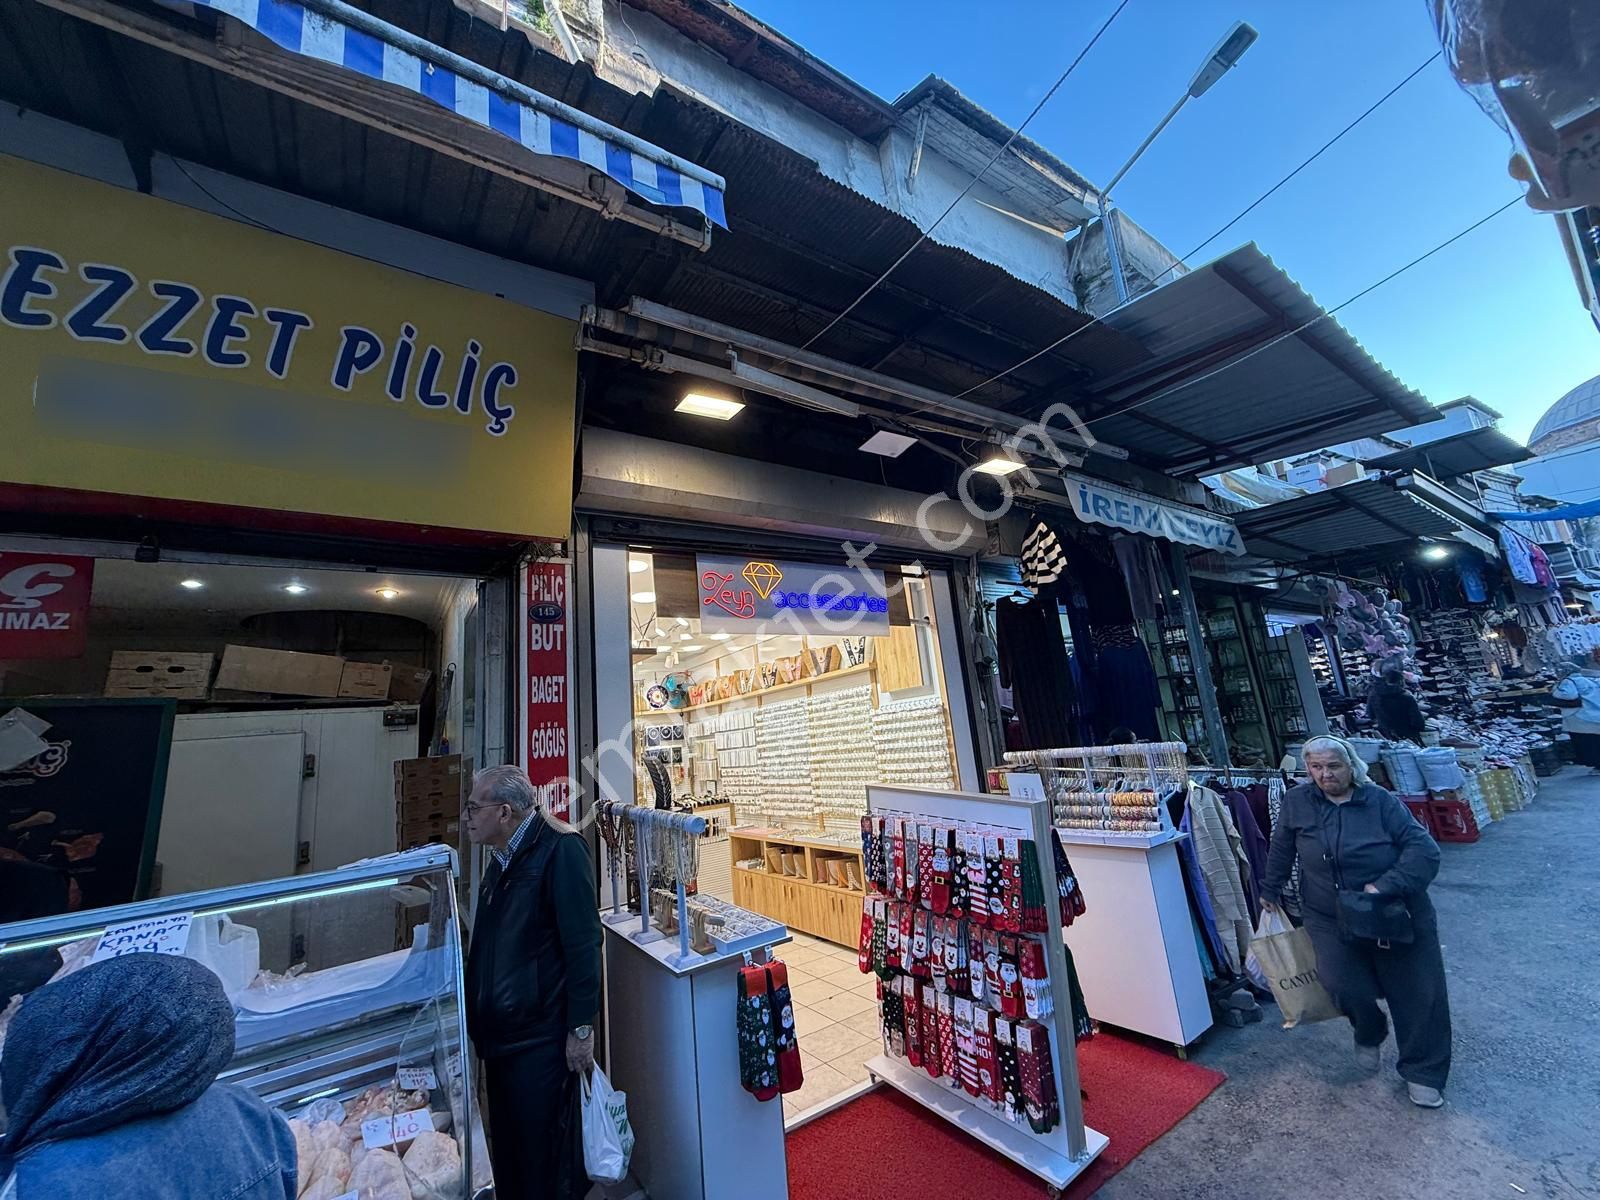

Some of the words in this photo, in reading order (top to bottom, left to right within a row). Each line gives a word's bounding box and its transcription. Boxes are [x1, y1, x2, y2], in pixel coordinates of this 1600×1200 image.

[0, 246, 313, 380] EZZET
[331, 322, 519, 436] PİLİÇ
[1078, 483, 1163, 531] İREM
[531, 567, 564, 607] PİLİÇ
[701, 569, 756, 620] Zeyn
[538, 607, 555, 617] 145
[531, 623, 564, 651] BUT
[531, 675, 565, 704] BAGET
[531, 721, 566, 760] GÖĞÜS
[98, 924, 189, 951] KANAT
